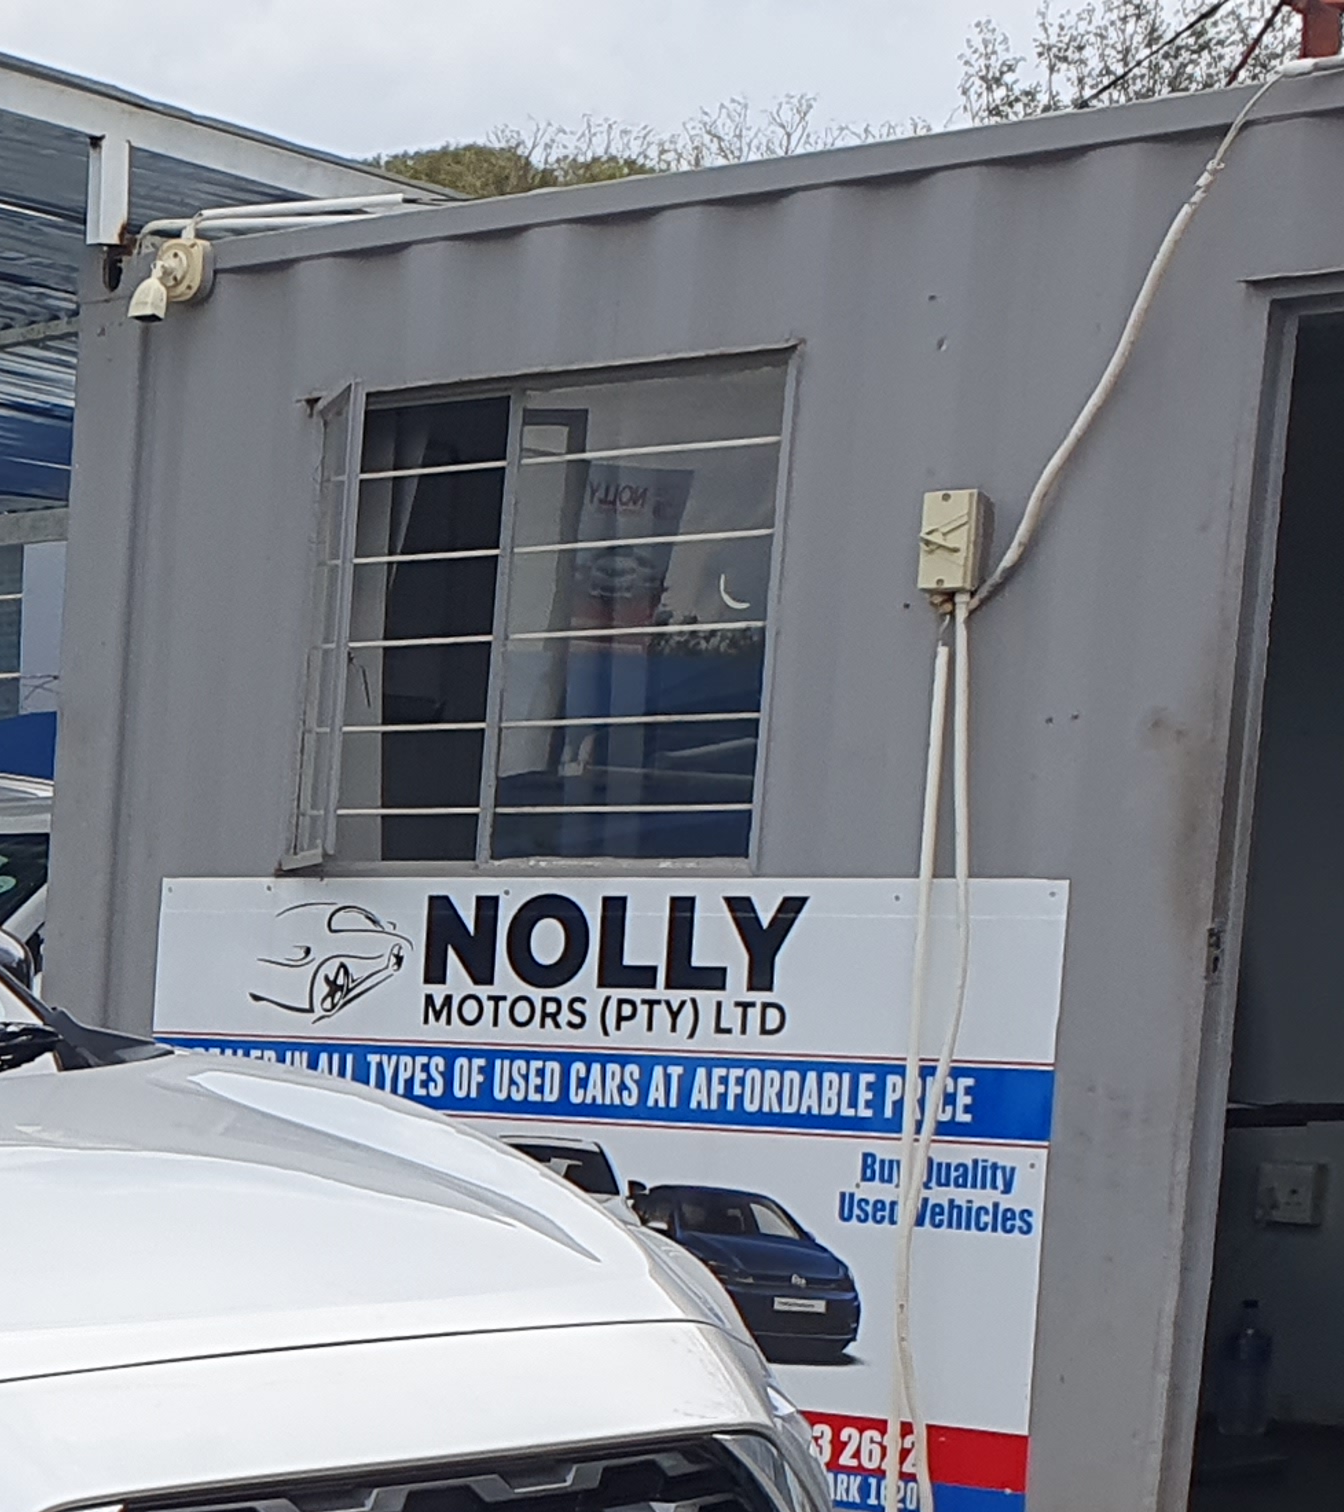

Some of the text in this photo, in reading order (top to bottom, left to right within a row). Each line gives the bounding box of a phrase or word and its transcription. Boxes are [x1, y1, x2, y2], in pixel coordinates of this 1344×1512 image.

[423, 893, 810, 991] NOLLY
[423, 993, 787, 1038] MOTORS (PTY) LTD
[367, 1054, 443, 1097] TYPES
[454, 1057, 483, 1098] OF
[493, 1059, 559, 1103] USED
[569, 1061, 639, 1106] CARS
[647, 1065, 683, 1108] AT
[690, 1067, 874, 1119] AFFORDABLE
